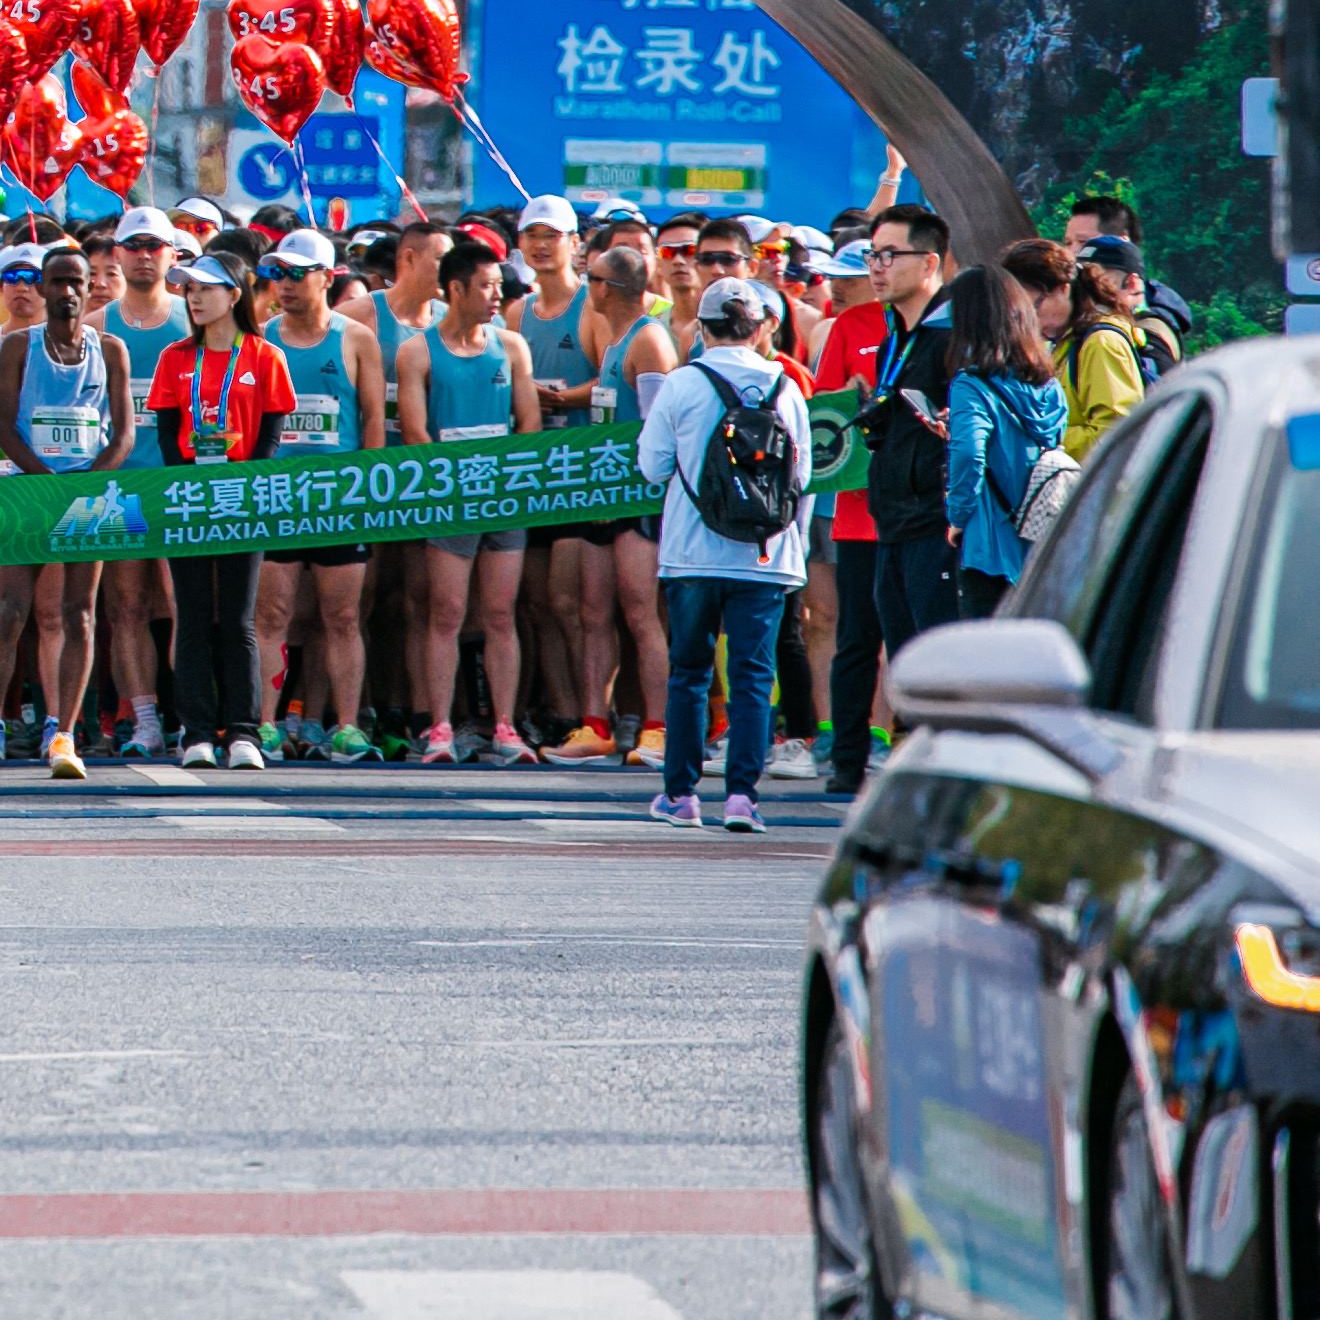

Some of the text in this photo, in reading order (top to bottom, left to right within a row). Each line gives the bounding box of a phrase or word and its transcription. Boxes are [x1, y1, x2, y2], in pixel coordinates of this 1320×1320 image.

[238, 7, 296, 36] 3:45
[555, 21, 782, 98] 检录处
[52, 427, 80, 443] 001
[284, 414, 324, 431] A1780
[163, 520, 270, 546] HUAXIA
[278, 513, 356, 537] BANK
[363, 504, 454, 528] MIYUN
[463, 495, 517, 518] ECO
